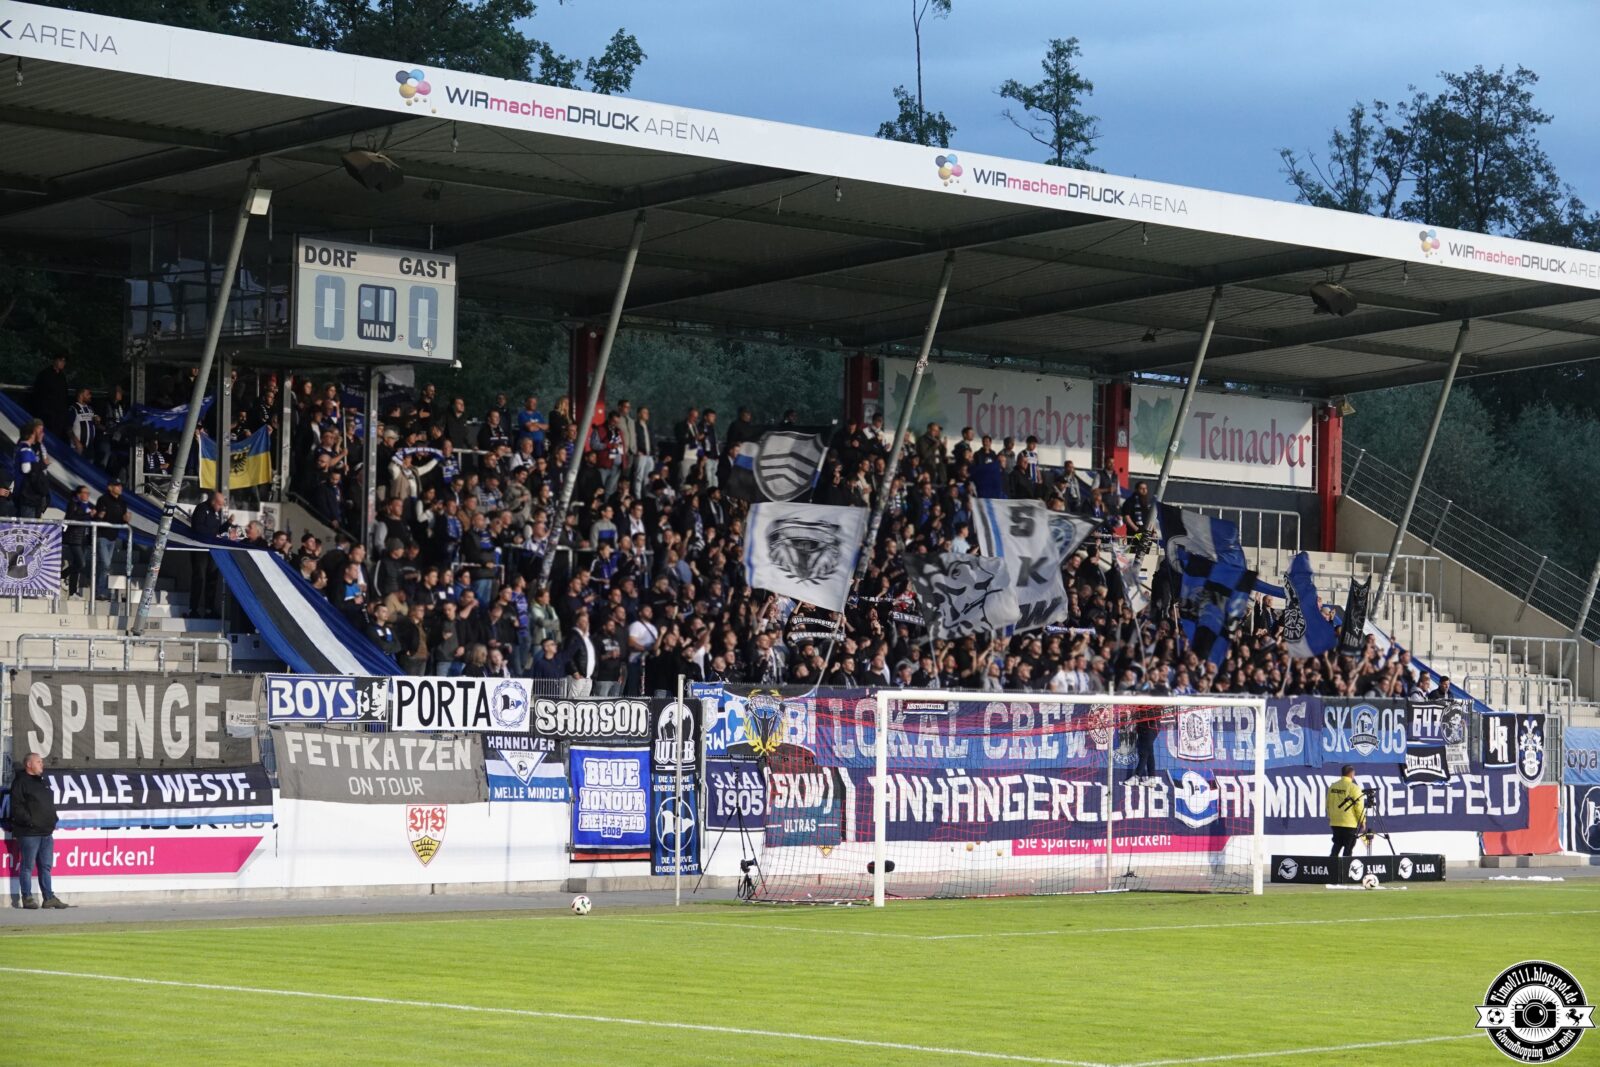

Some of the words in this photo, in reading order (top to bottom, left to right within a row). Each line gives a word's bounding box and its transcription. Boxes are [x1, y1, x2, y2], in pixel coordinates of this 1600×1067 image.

[19, 22, 118, 55] ARENA
[446, 85, 639, 132] WIRmachenDRUCK
[644, 118, 720, 144] ARENA
[973, 167, 1125, 205] WIRmachenDRUCK
[1128, 192, 1188, 215] ARENA
[304, 245, 357, 268] DORF
[399, 256, 450, 279] GAST
[1449, 242, 1566, 273] WIRmachenDRUCK
[363, 323, 390, 339] MIN
[958, 388, 1092, 448] Teinacher
[1194, 411, 1311, 468] Teinacher
[270, 680, 358, 722] BOYS
[396, 680, 492, 727] PORTA
[27, 681, 220, 760] SPENGE
[535, 698, 651, 736] SAMSON
[829, 697, 969, 759] LOKAL
[983, 701, 1088, 760] CREW
[1166, 702, 1306, 761] TRAS
[1323, 706, 1350, 753] SK
[1381, 707, 1406, 754] 05
[1412, 707, 1442, 737] 647
[284, 731, 472, 771] FETTKATZEN
[487, 735, 556, 751] HANNOVER
[584, 759, 639, 788] BLUE
[1564, 748, 1598, 774] opa
[153, 772, 256, 803] WESTF.
[349, 776, 374, 796] ON
[376, 777, 424, 796] TOUR
[494, 786, 525, 799] MELLE
[527, 787, 565, 799] MINDEN
[580, 789, 645, 811] HONOUR
[867, 768, 1170, 822] ANHÄNGERCLUB
[1218, 774, 1334, 819] ARMINI
[716, 789, 764, 816] 1905
[602, 827, 621, 836] 2008
[784, 819, 816, 833] ULTRAS
[66, 845, 155, 868] drucken!
[1311, 866, 1329, 876] LIGA
[1373, 864, 1387, 874] LIGA
[1422, 863, 1435, 873] LIGA
